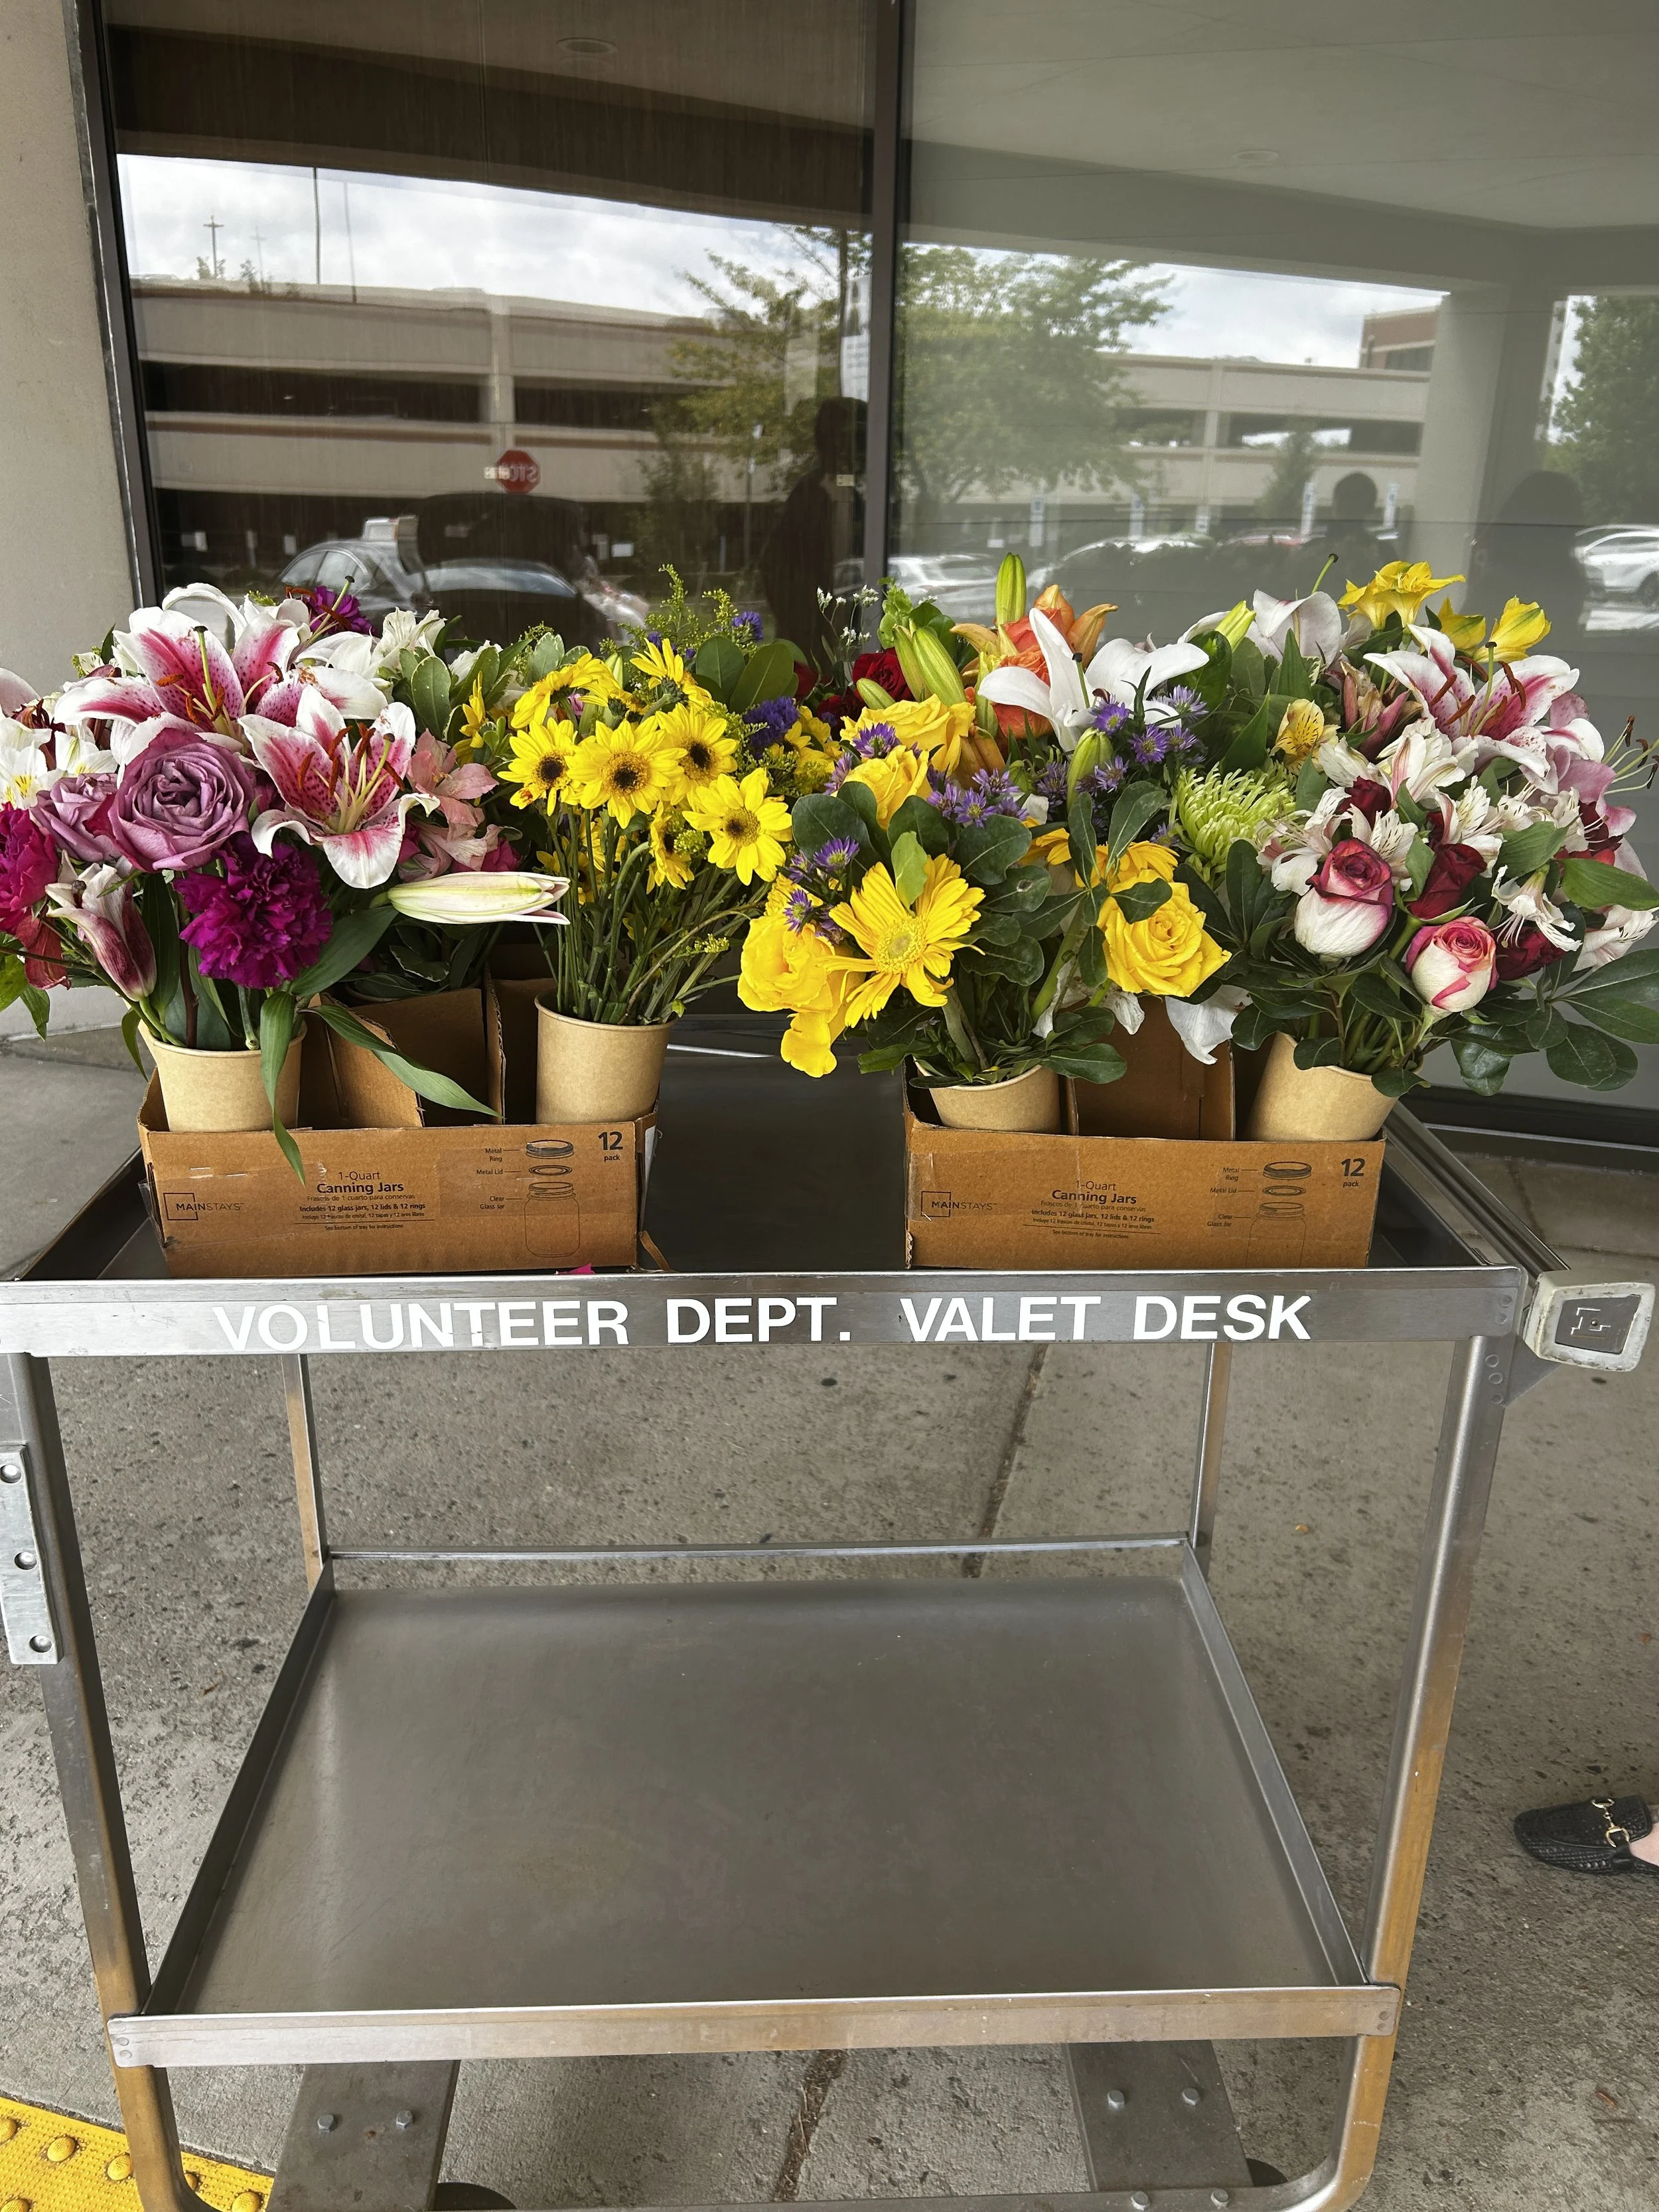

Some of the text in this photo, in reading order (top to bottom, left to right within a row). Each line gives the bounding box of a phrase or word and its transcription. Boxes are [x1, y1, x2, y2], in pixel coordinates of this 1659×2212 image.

[598, 1132, 623, 1151] 12
[1341, 1158, 1366, 1177] 12
[338, 1171, 381, 1181] 1-Quart
[317, 1182, 404, 1195] Canning Jars
[1076, 1181, 1117, 1191] 1-Quart
[1052, 1189, 1137, 1205] Canning Jars
[175, 1203, 242, 1211] MAINSTAYS
[931, 1201, 993, 1210] MAINSTAYS
[212, 1294, 1312, 1351] VOLUNTEER DEPT. VALET DESK
